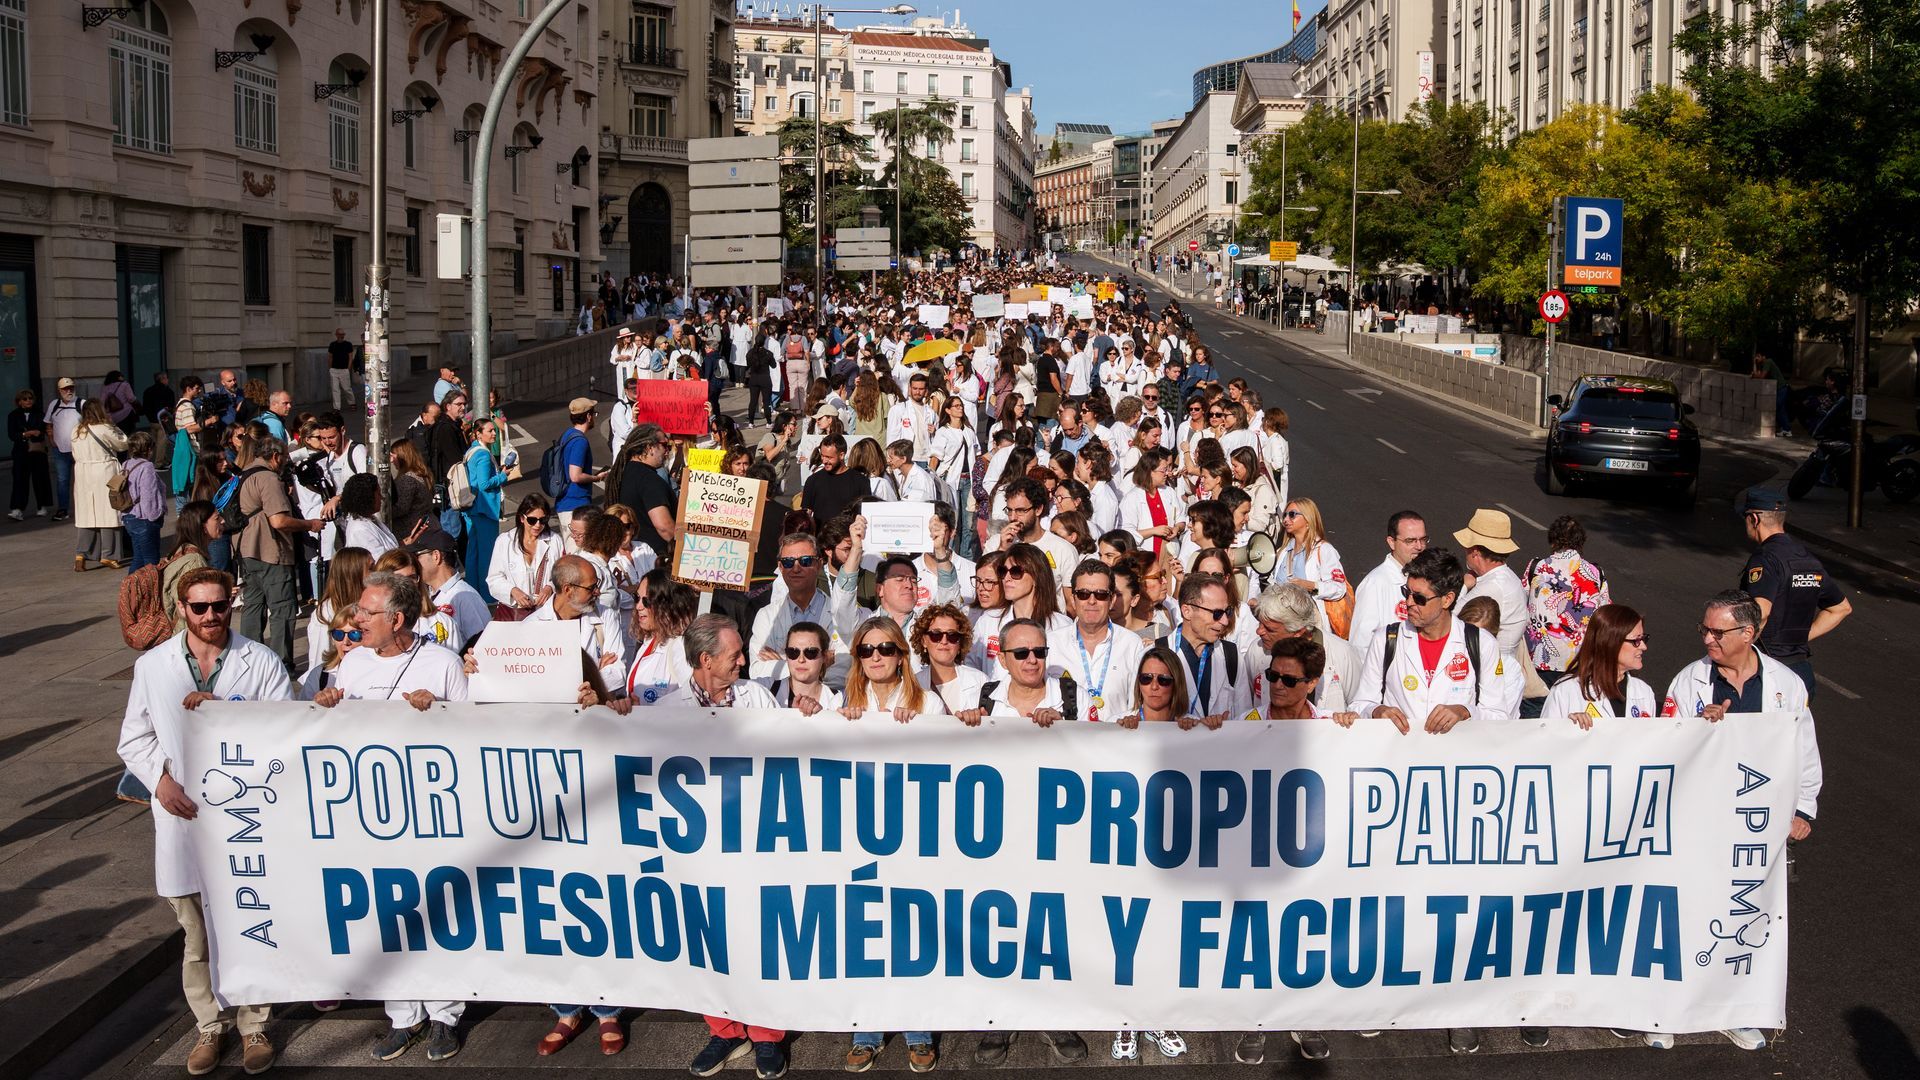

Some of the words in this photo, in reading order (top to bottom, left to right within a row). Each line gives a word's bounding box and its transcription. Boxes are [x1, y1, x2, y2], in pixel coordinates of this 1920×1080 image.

[858, 48, 901, 57] ORGANIZACIÓN
[965, 54, 987, 62] ESPAÑA
[1576, 206, 1611, 260] P
[1595, 251, 1612, 261] 24h
[1574, 268, 1613, 280] telpark
[702, 502, 719, 513] NO
[687, 522, 747, 540] MALTRATADA
[683, 533, 712, 551] NO
[718, 541, 738, 555] AL
[680, 552, 747, 571] ESTATUTO
[693, 569, 743, 583] MARCO
[1792, 580, 1821, 588] NACIONAL
[484, 647, 498, 657] YO
[500, 647, 536, 657] APOYO
[538, 647, 546, 657] A
[549, 647, 563, 657] MI
[504, 662, 546, 674] MÉDICO
[301, 744, 465, 840] POR
[480, 747, 590, 846] UN
[614, 754, 1005, 860] ESTATUTO
[1036, 766, 1327, 870] PROPIO
[1347, 765, 1559, 869] PARA
[1583, 763, 1676, 864] LA
[321, 855, 731, 976] PROFESIÓN
[760, 860, 1073, 981] MÉDICA
[1102, 895, 1152, 987] Y
[1178, 884, 1684, 990] FACULTATIVA
